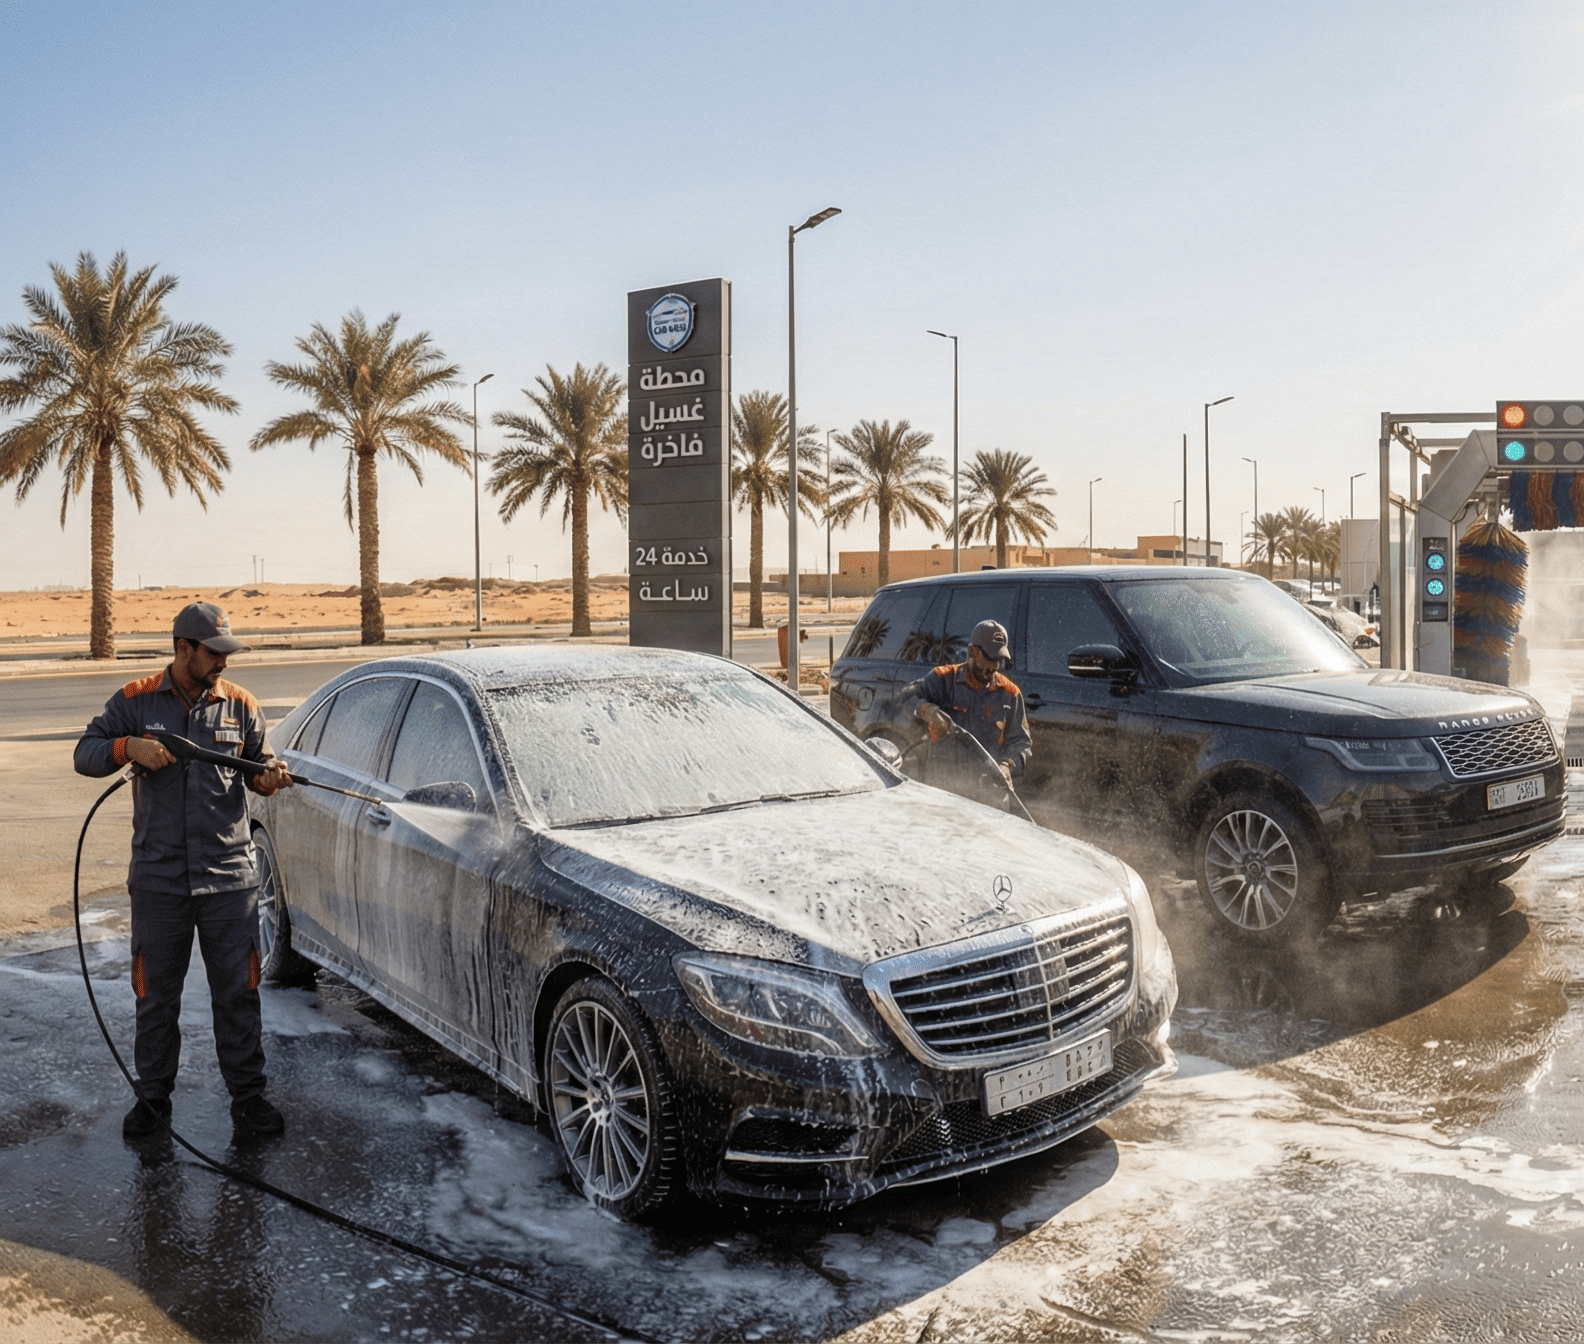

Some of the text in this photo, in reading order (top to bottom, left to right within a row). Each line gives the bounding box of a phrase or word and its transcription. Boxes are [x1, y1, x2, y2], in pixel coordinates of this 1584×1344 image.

[640, 365, 705, 391] محطة
[640, 397, 705, 432] غسيل
[641, 433, 703, 467] فاخرة
[635, 546, 708, 566] خدمة 24
[639, 579, 709, 602] ساعة
